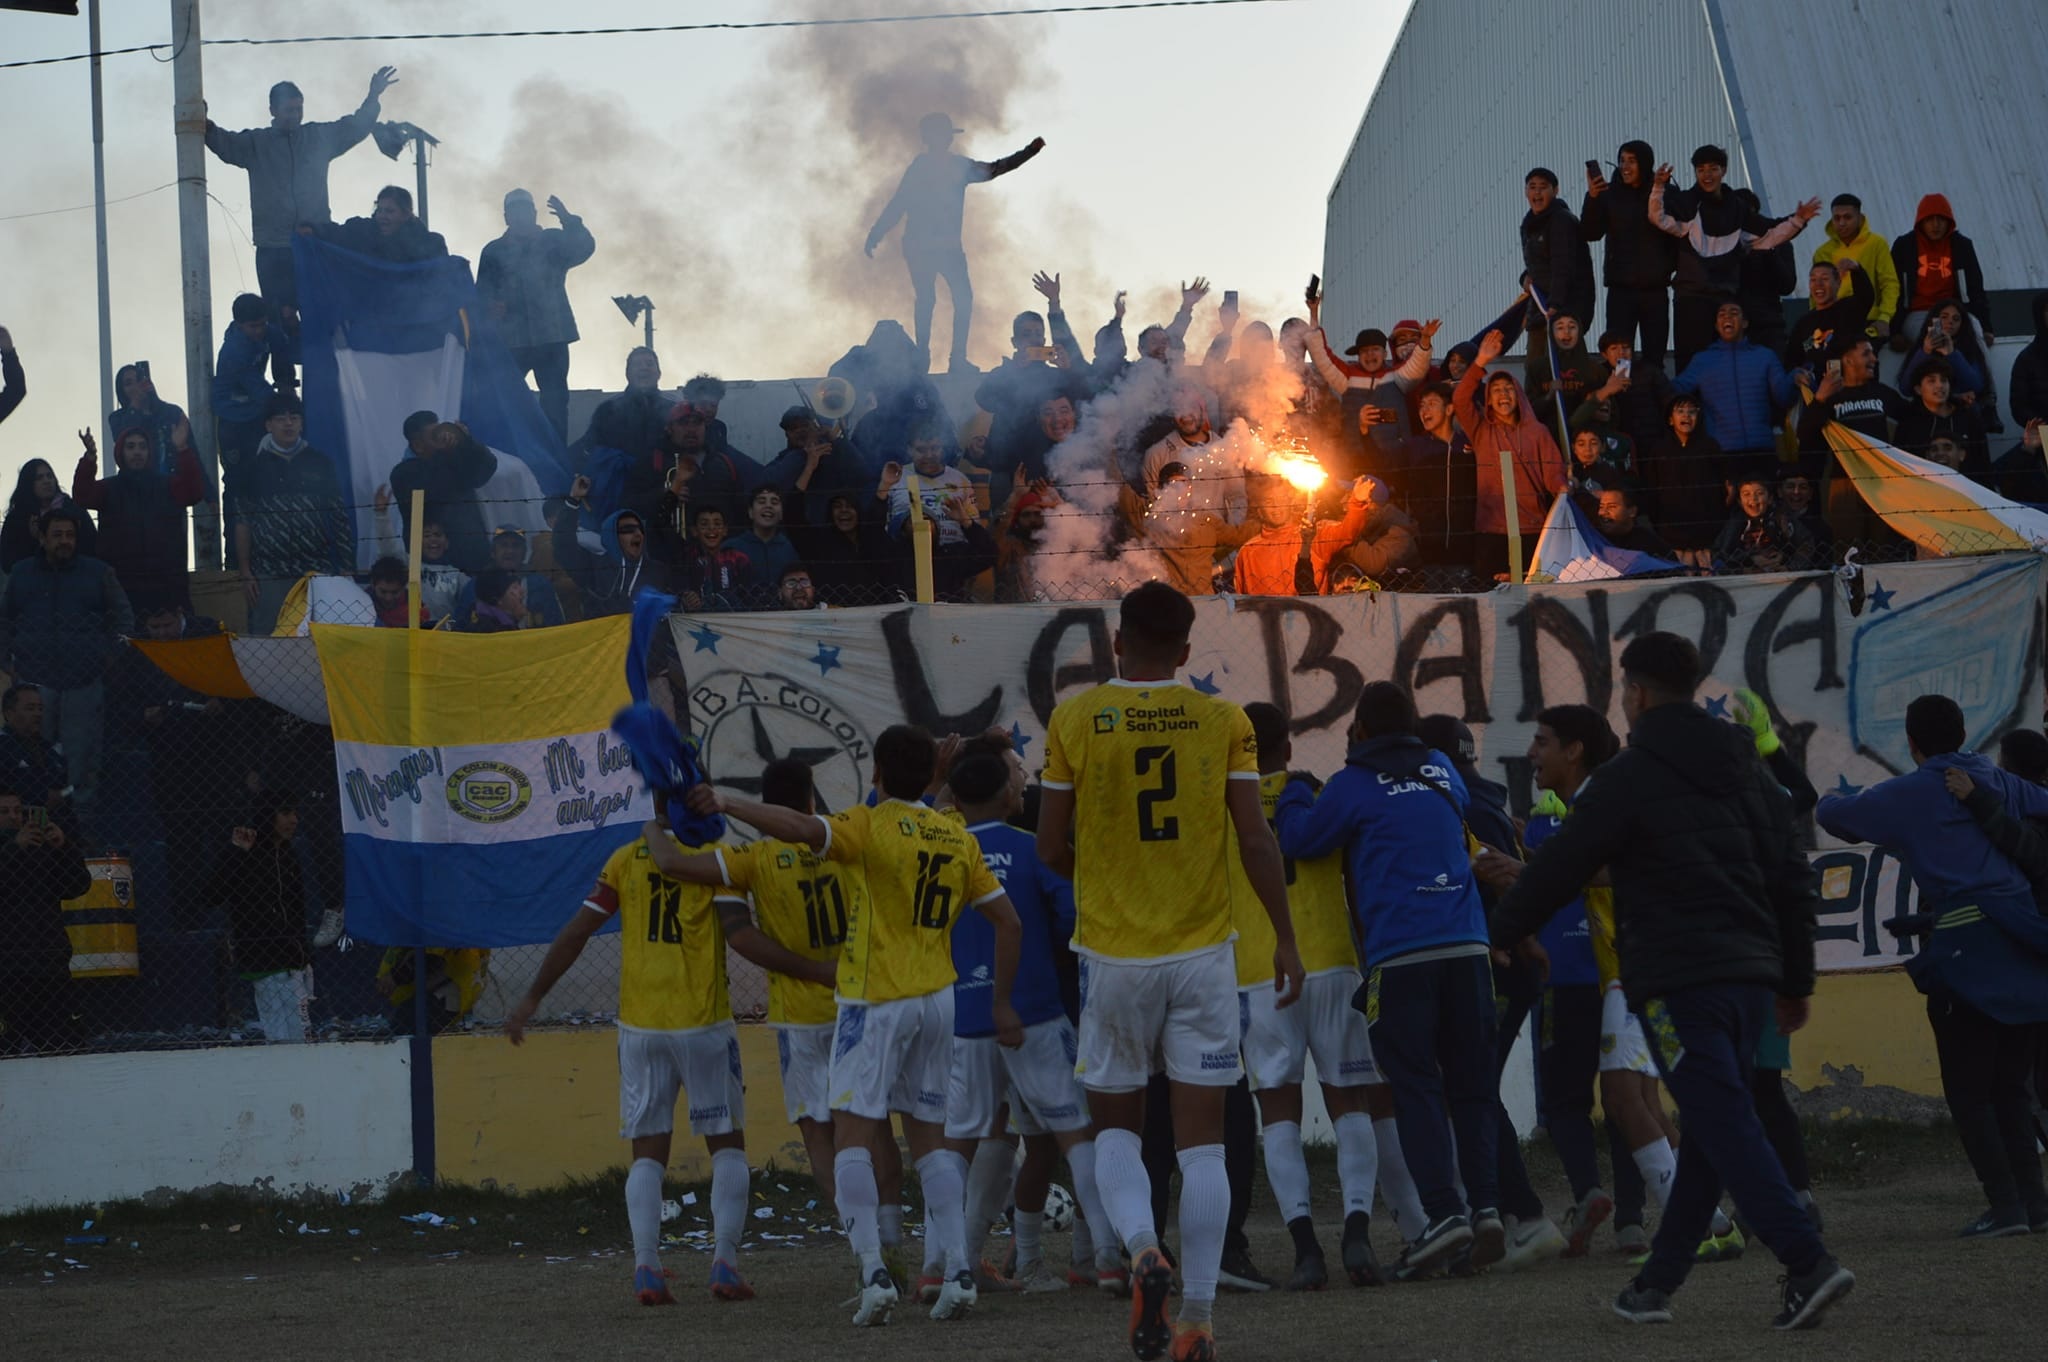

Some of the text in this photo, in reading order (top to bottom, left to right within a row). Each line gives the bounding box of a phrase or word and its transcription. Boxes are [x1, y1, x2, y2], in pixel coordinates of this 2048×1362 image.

[1833, 398, 1885, 420] THRASHER
[779, 685, 869, 761] COLON
[1125, 705, 1186, 719] Capital
[543, 732, 632, 795] Mi bue
[1134, 745, 1179, 842] 2
[1376, 764, 1451, 785] CON
[797, 874, 849, 949] 10
[911, 850, 955, 929] 16
